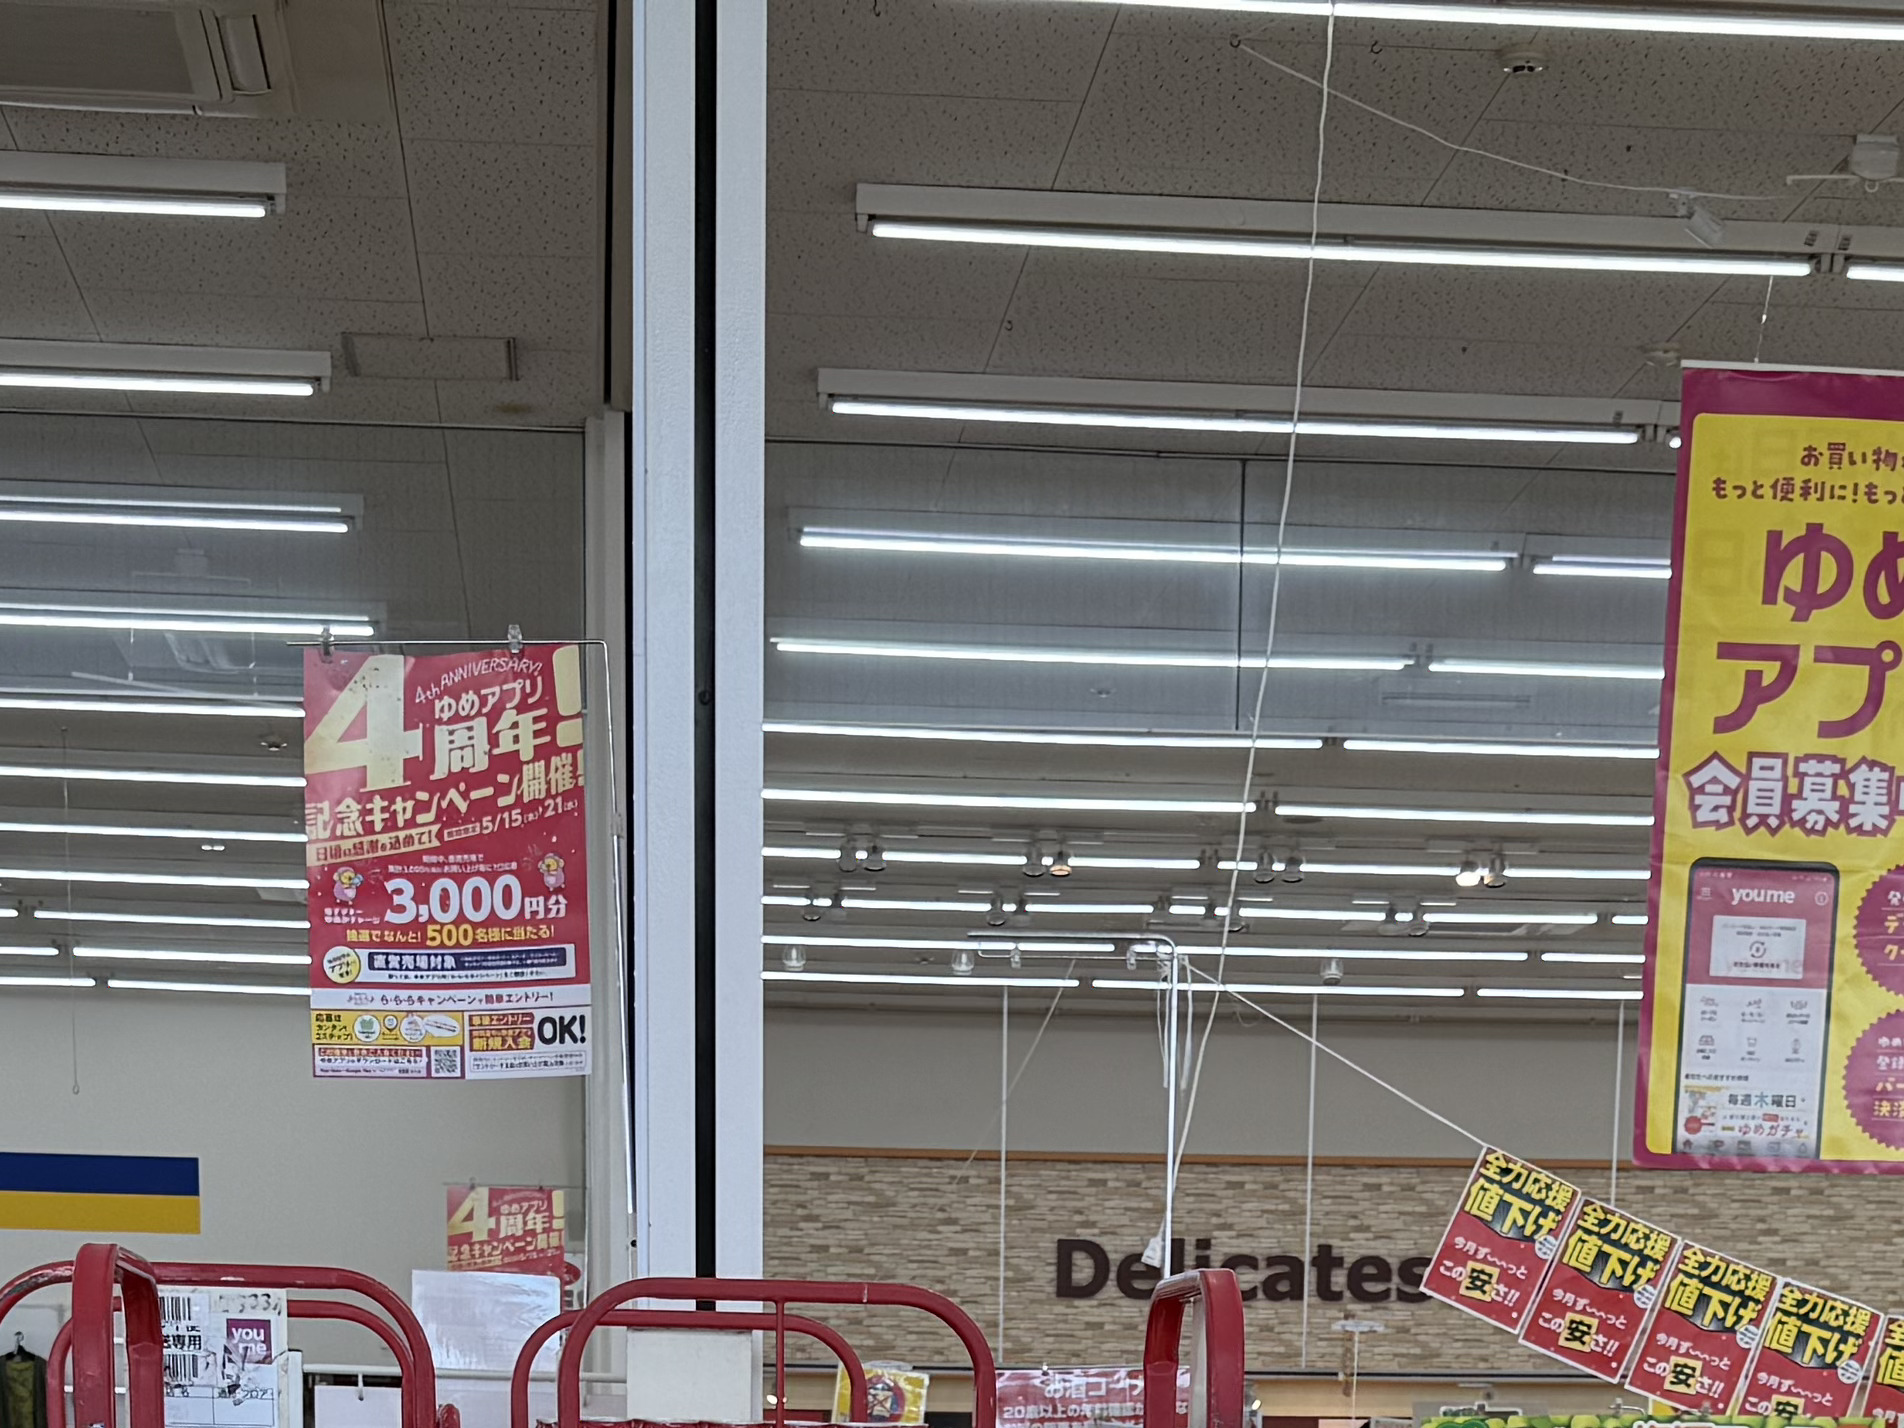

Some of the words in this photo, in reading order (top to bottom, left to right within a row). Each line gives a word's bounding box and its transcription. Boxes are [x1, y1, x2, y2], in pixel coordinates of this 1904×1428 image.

[435, 676, 542, 721] ゆめアプリ
[440, 657, 543, 689] ANNIVERSARY!
[537, 1015, 586, 1045] OK!
[1479, 1155, 1573, 1212] 全力応援
[1464, 1180, 1560, 1247] 値下げ
[1576, 1203, 1673, 1262] 全力応援
[1564, 1230, 1659, 1294] 値下げ
[1682, 1246, 1773, 1301] 全力応援
[1666, 1272, 1763, 1335] 値下げ
[1778, 1285, 1872, 1334] 全力応援
[1764, 1311, 1860, 1369] 値下げ
